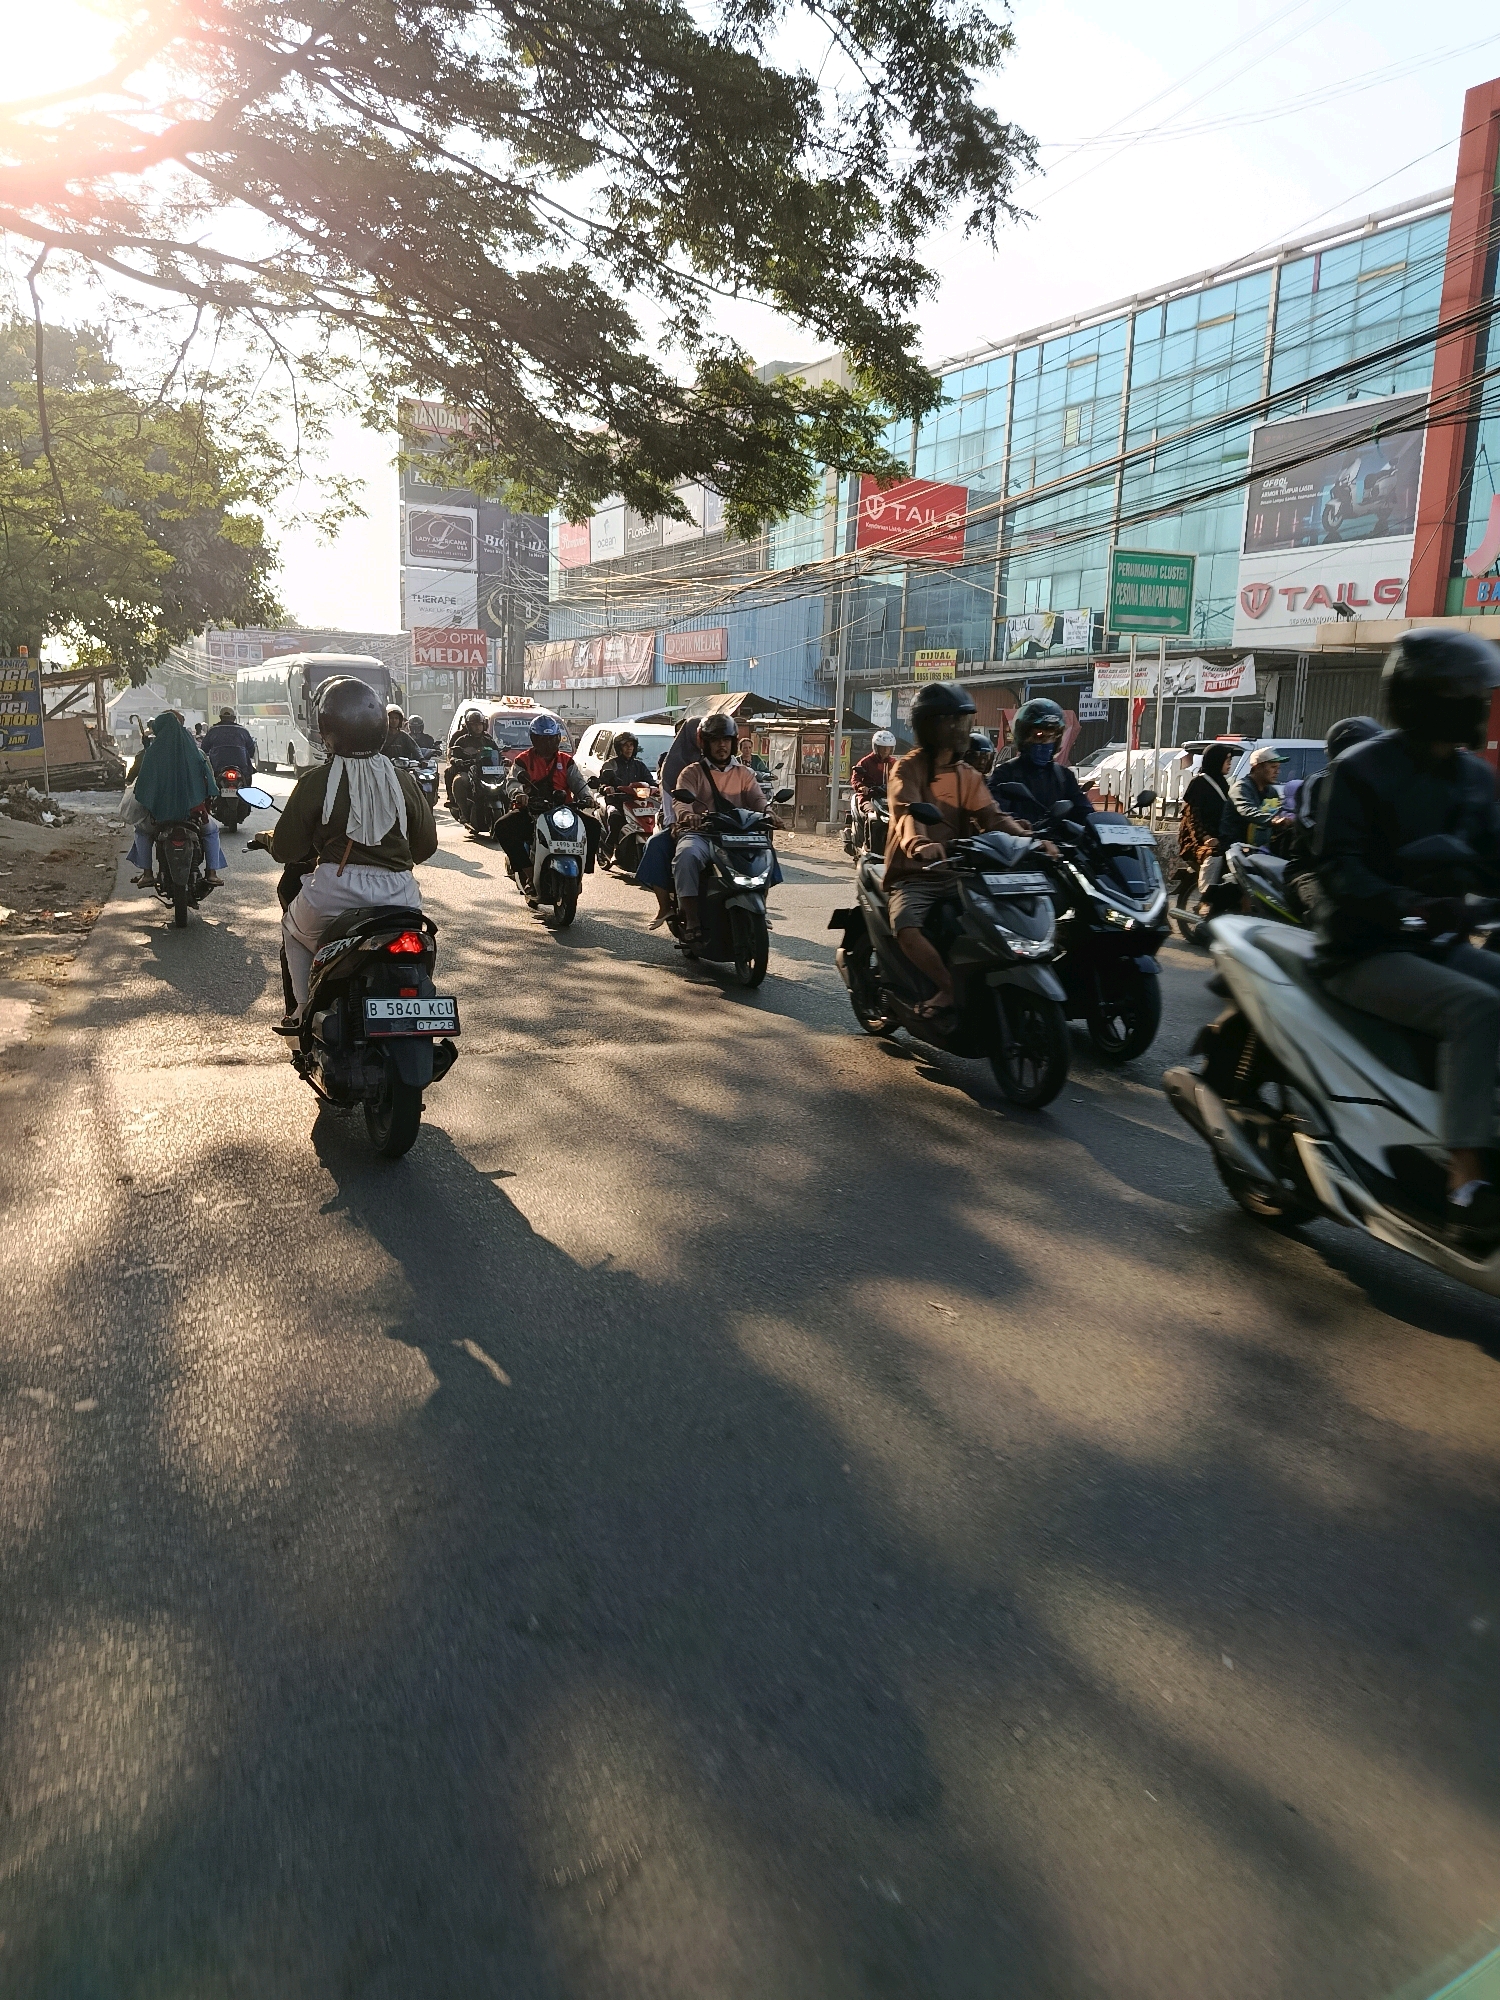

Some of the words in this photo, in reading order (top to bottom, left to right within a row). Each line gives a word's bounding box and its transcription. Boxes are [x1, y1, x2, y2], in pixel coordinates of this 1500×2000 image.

[628, 521, 659, 540] FLORESTA
[597, 536, 617, 549] ocean
[1117, 562, 1159, 579] PERUMAHAN
[1160, 565, 1188, 581] CLUSTER
[1115, 582, 1139, 606] PESONA
[1139, 584, 1168, 608] HARAPAN
[1168, 585, 1187, 609] INDAH
[1278, 577, 1403, 612] TAILG
[450, 633, 485, 645] OPTIK
[676, 636, 694, 653] OPTIK
[694, 633, 721, 652] MEDIA
[418, 649, 485, 665] MEDIA
[920, 652, 951, 660] DIJUAL
[210, 691, 230, 702] BIG
[369, 1002, 378, 1016] B
[386, 1002, 421, 1016] 5840
[429, 1002, 454, 1015] KCU
